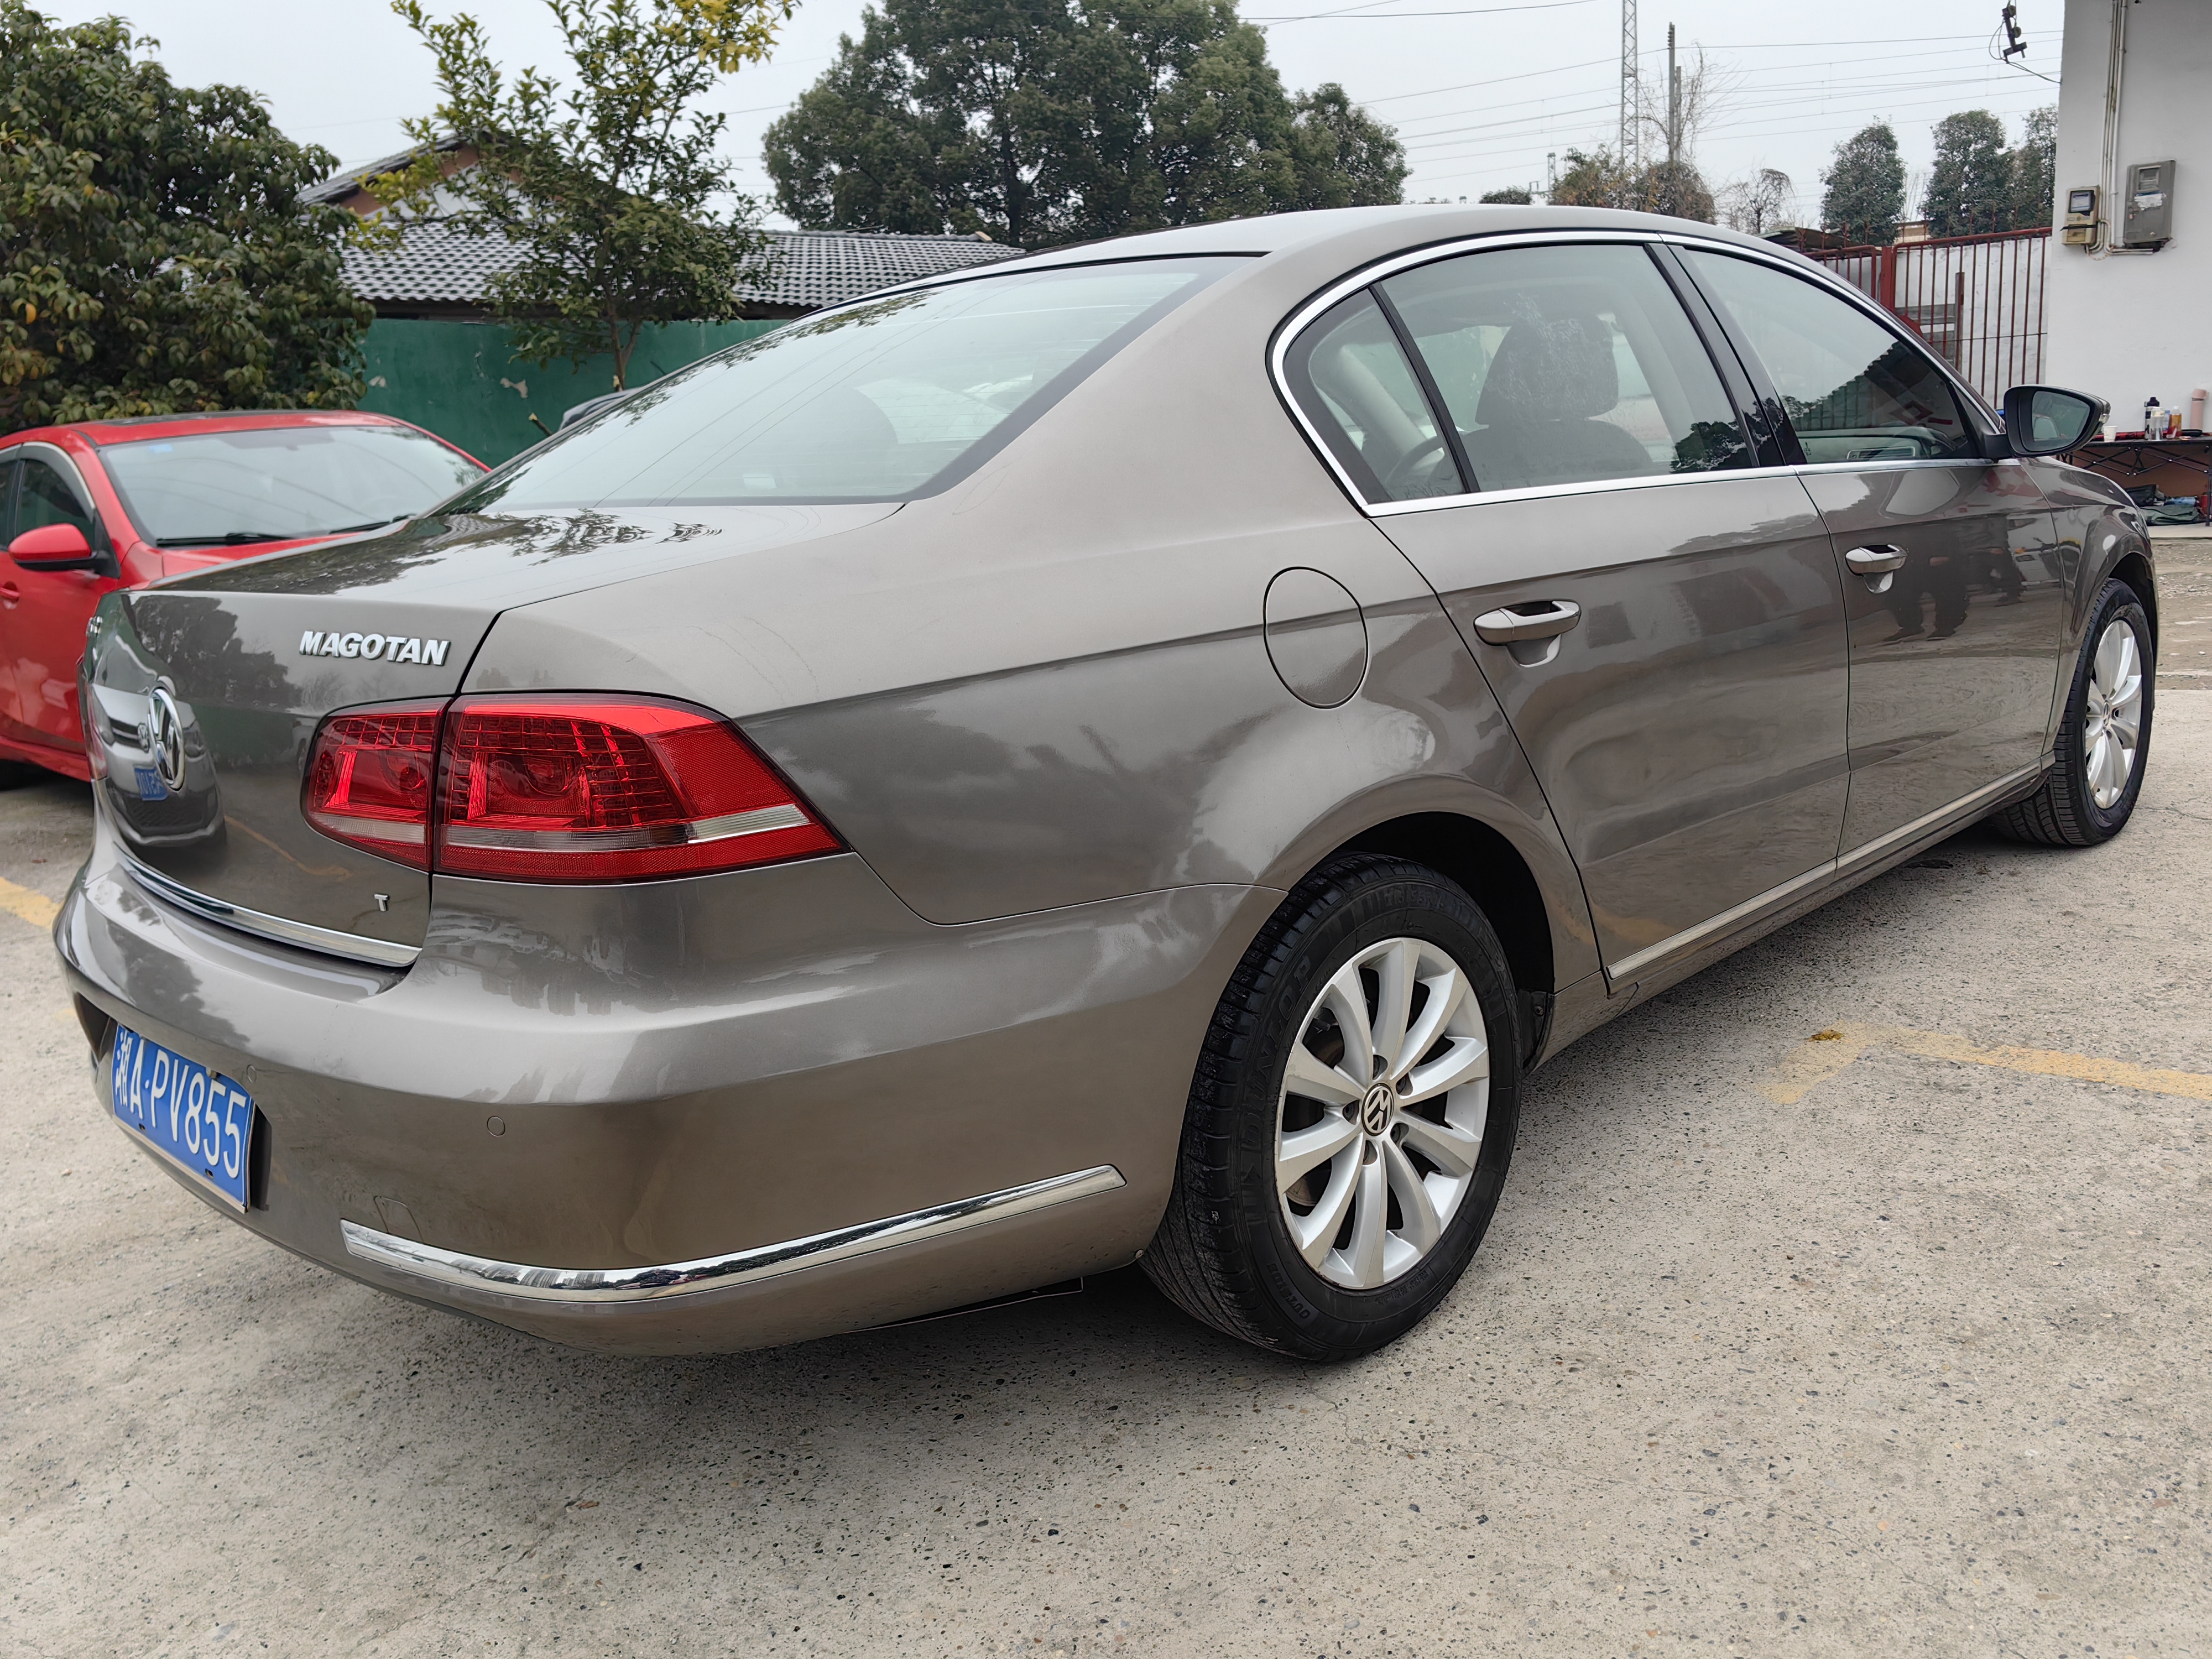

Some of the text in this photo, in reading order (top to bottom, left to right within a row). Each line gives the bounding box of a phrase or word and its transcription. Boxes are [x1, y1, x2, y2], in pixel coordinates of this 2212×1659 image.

[300, 630, 450, 666] MAGOTAN
[374, 894, 390, 912] T
[1241, 955, 1312, 1151] DUNLOP
[1266, 1262, 1311, 1319] OUTSIDE
